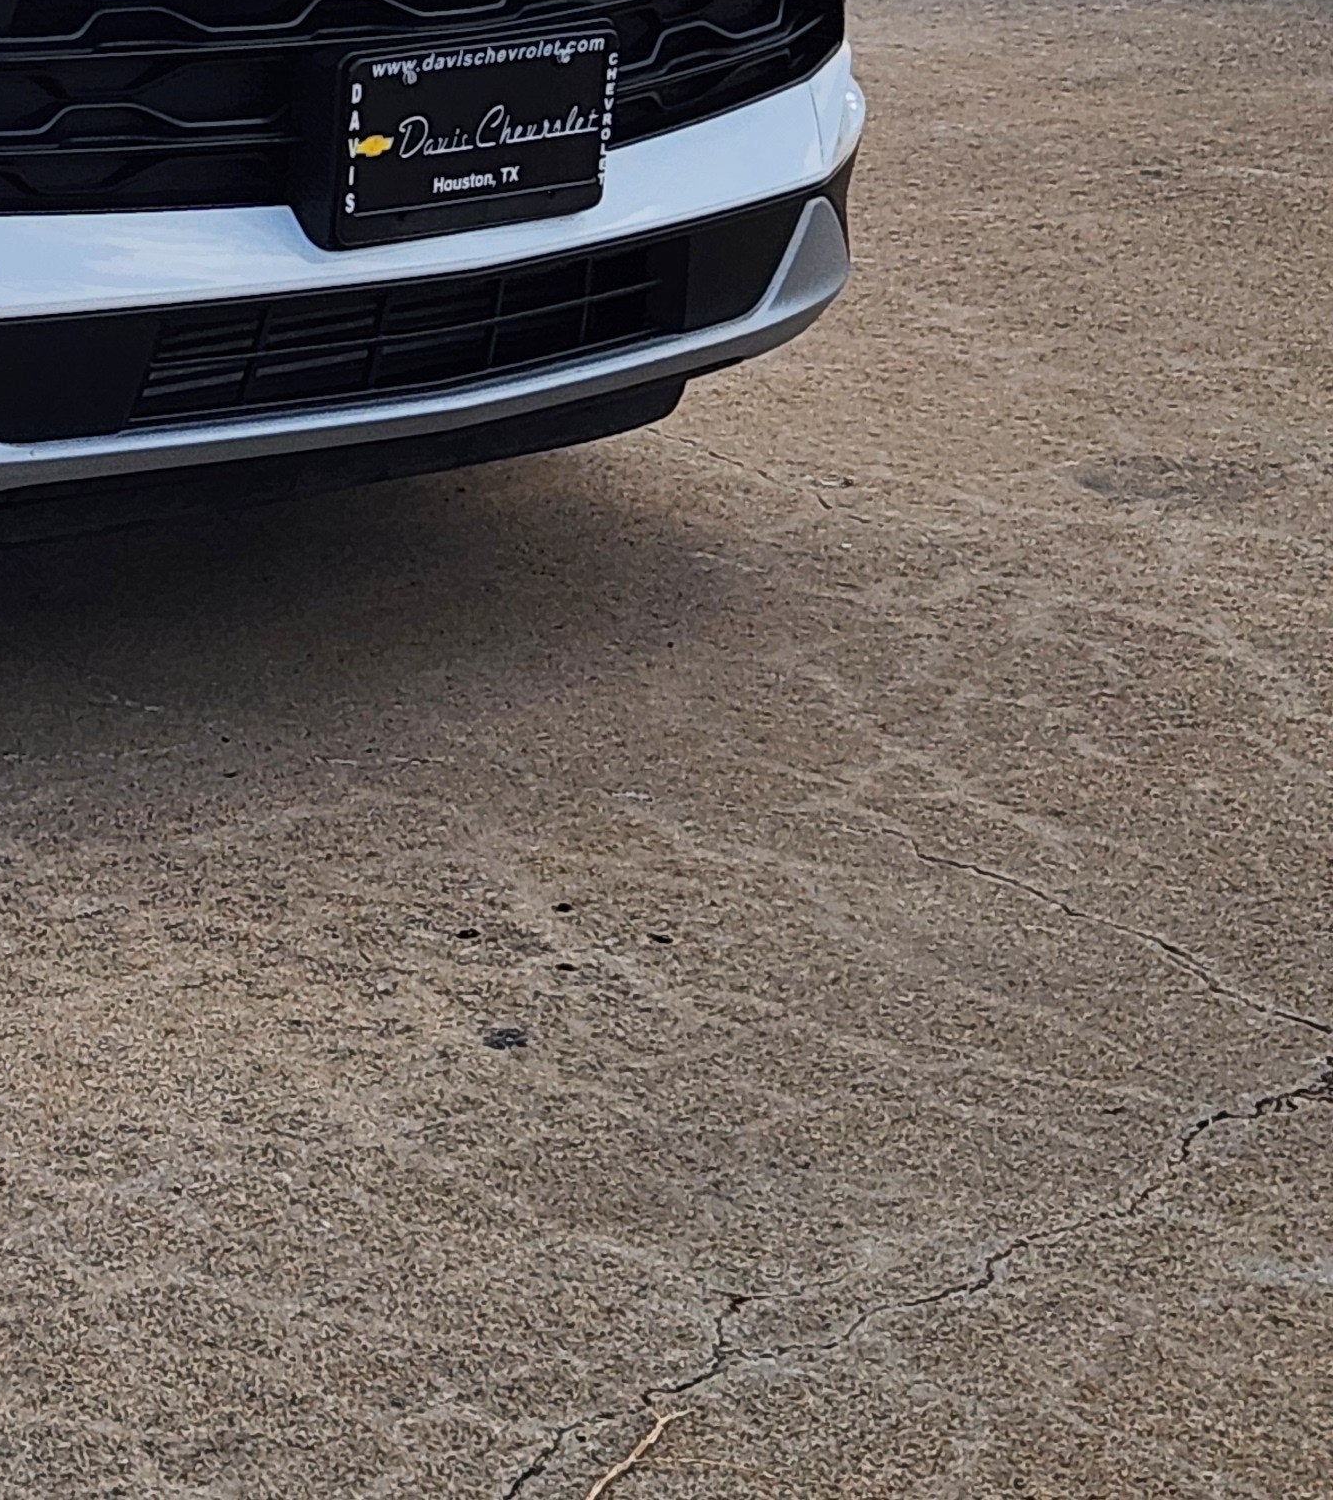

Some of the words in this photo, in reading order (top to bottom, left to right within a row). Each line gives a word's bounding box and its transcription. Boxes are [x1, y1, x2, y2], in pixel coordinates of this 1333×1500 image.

[371, 37, 606, 78] www.davischevrolet.com
[344, 82, 363, 214] DAVIS
[398, 115, 474, 159] Davis
[475, 103, 600, 148] Chevrolet
[432, 168, 498, 194] Houston,
[500, 166, 521, 184] TX
